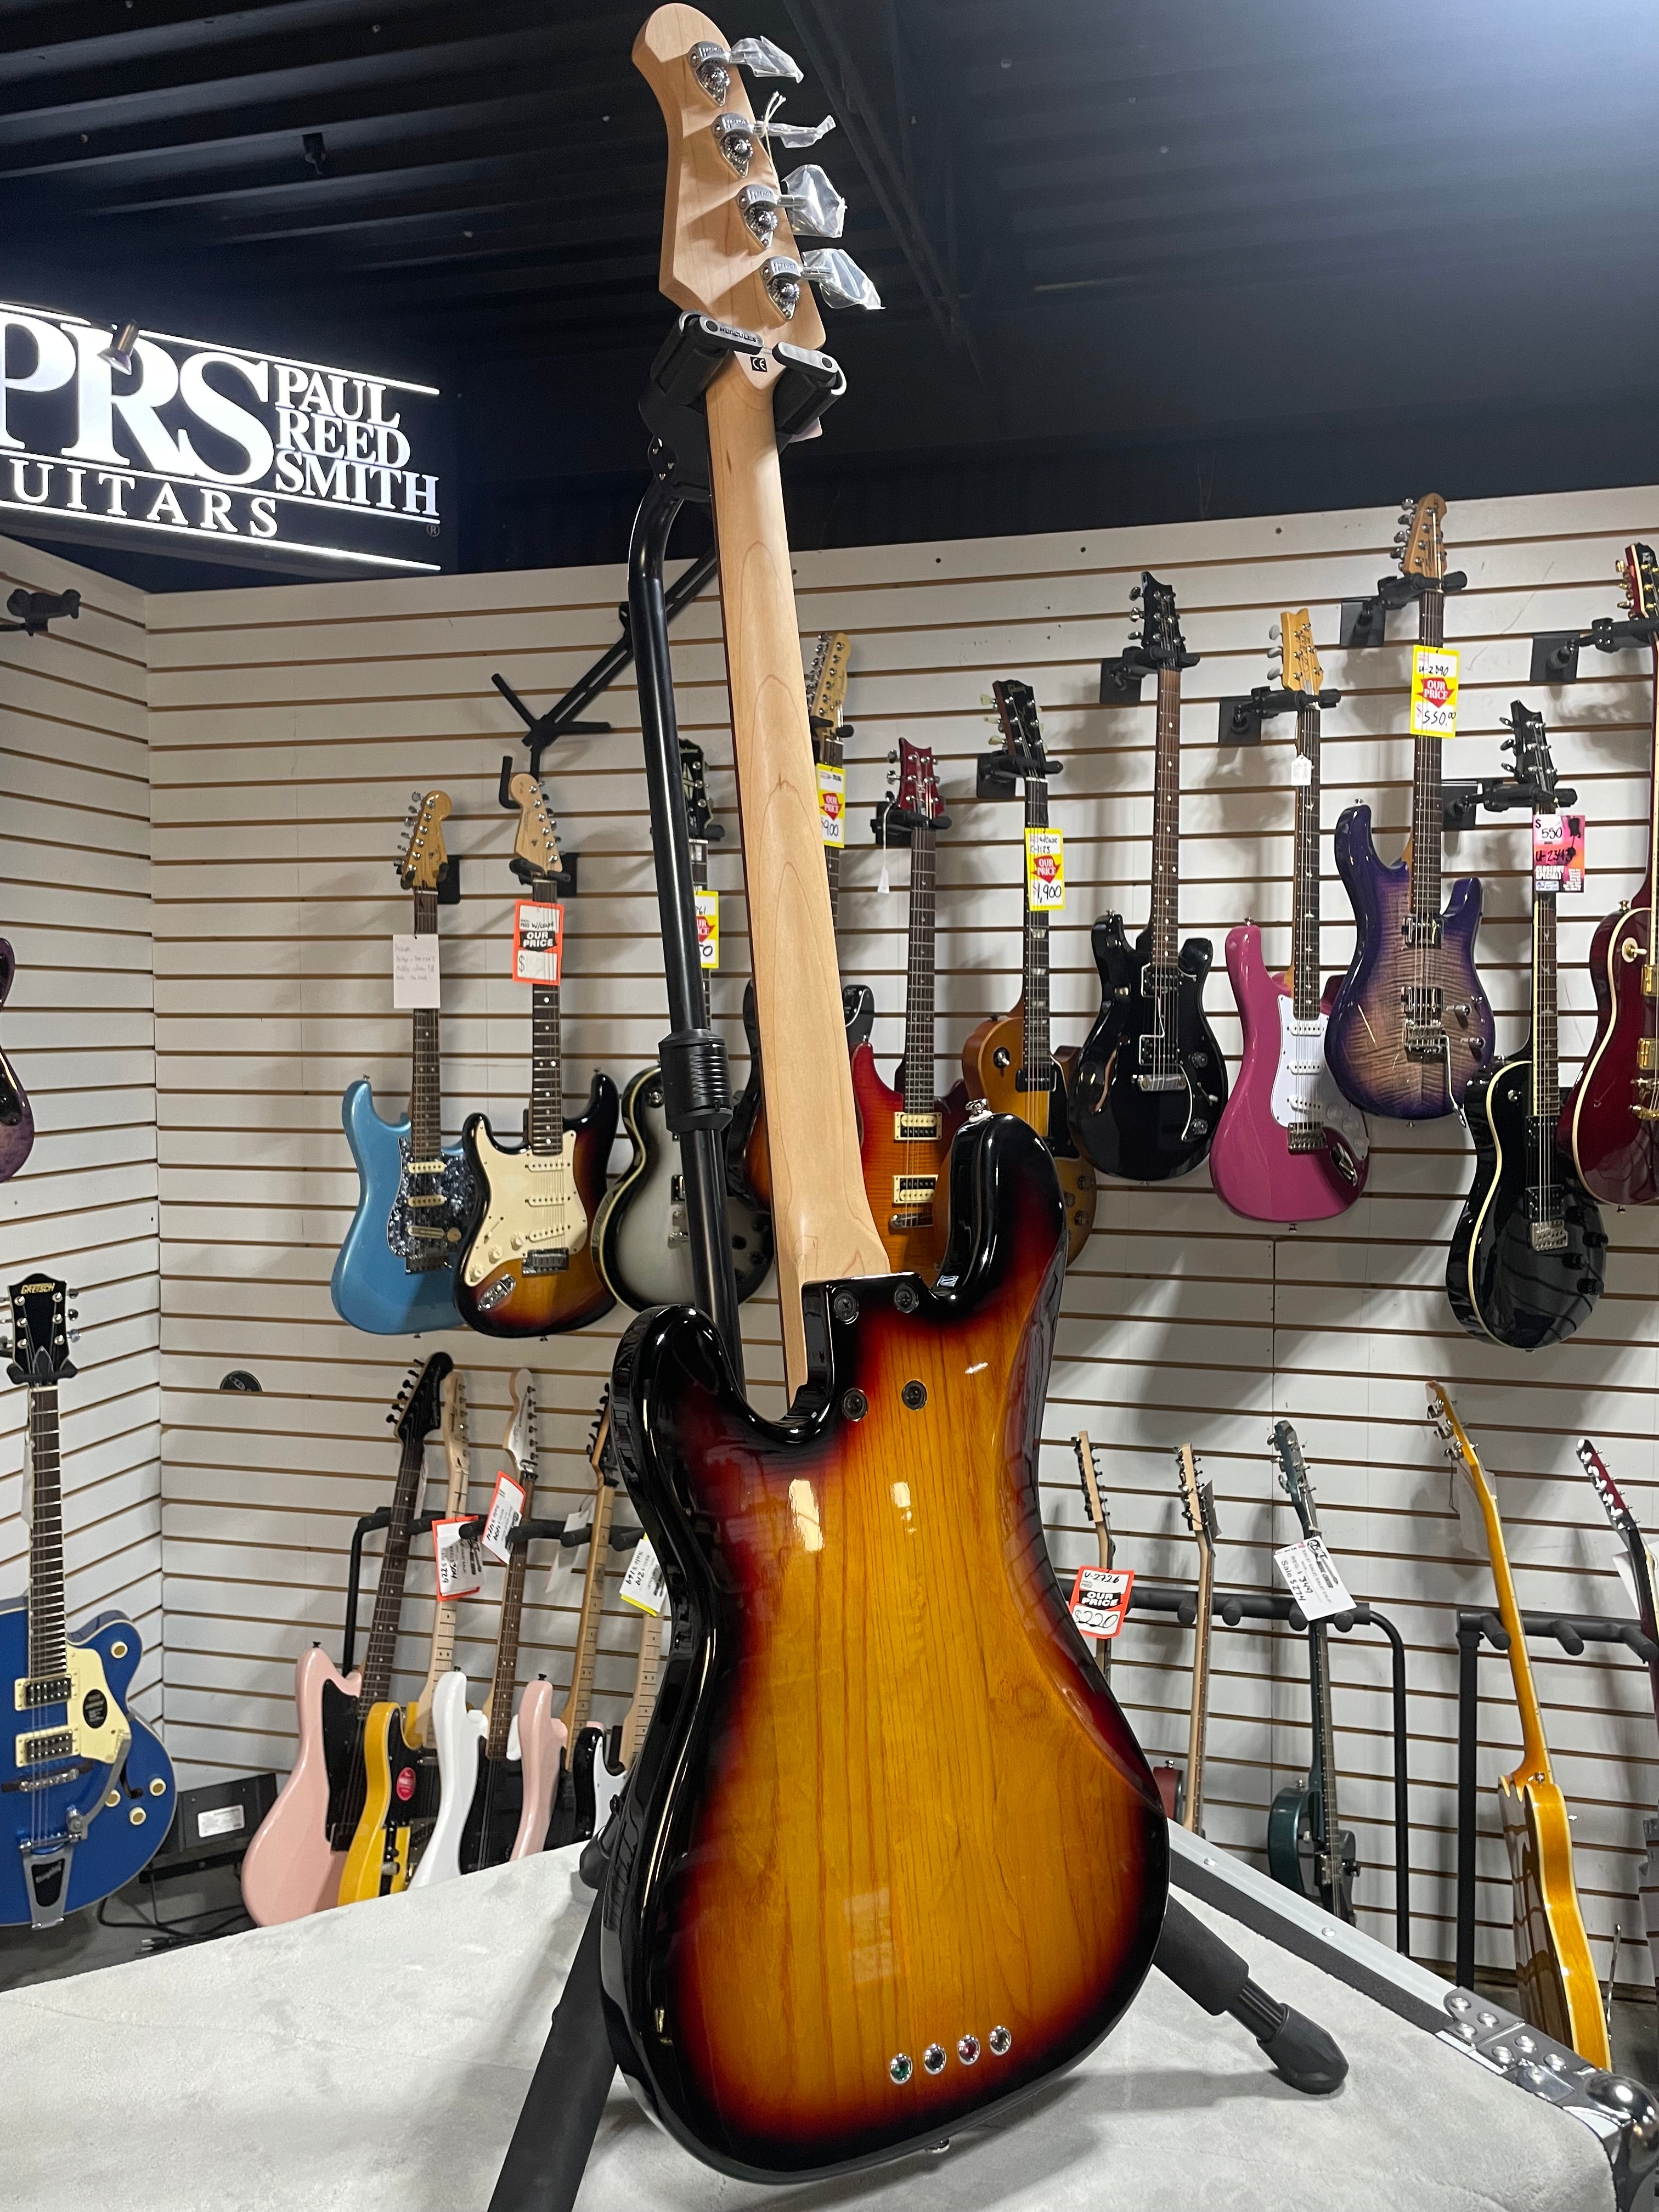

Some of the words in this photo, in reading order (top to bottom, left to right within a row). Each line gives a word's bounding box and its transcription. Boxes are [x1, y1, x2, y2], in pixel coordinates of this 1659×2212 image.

[719, 326, 757, 342] HERCULES
[0, 314, 275, 485] PRS
[274, 364, 400, 429] PAUL
[275, 406, 411, 470] REED
[275, 450, 440, 517] SMITH
[9, 458, 279, 538] UITARS
[1426, 680, 1446, 690] OUR
[1424, 688, 1449, 701] PRICE
[826, 795, 838, 805] OUR
[825, 803, 839, 814] PRICE
[1038, 858, 1054, 868] OUR
[1037, 866, 1057, 876] PRICE
[527, 932, 549, 940] OUR
[523, 939, 554, 947] PRICE
[1282, 1560, 1292, 1578] Sale
[1086, 1592, 1114, 1600] OUR
[1081, 1597, 1119, 1607] PRICE
